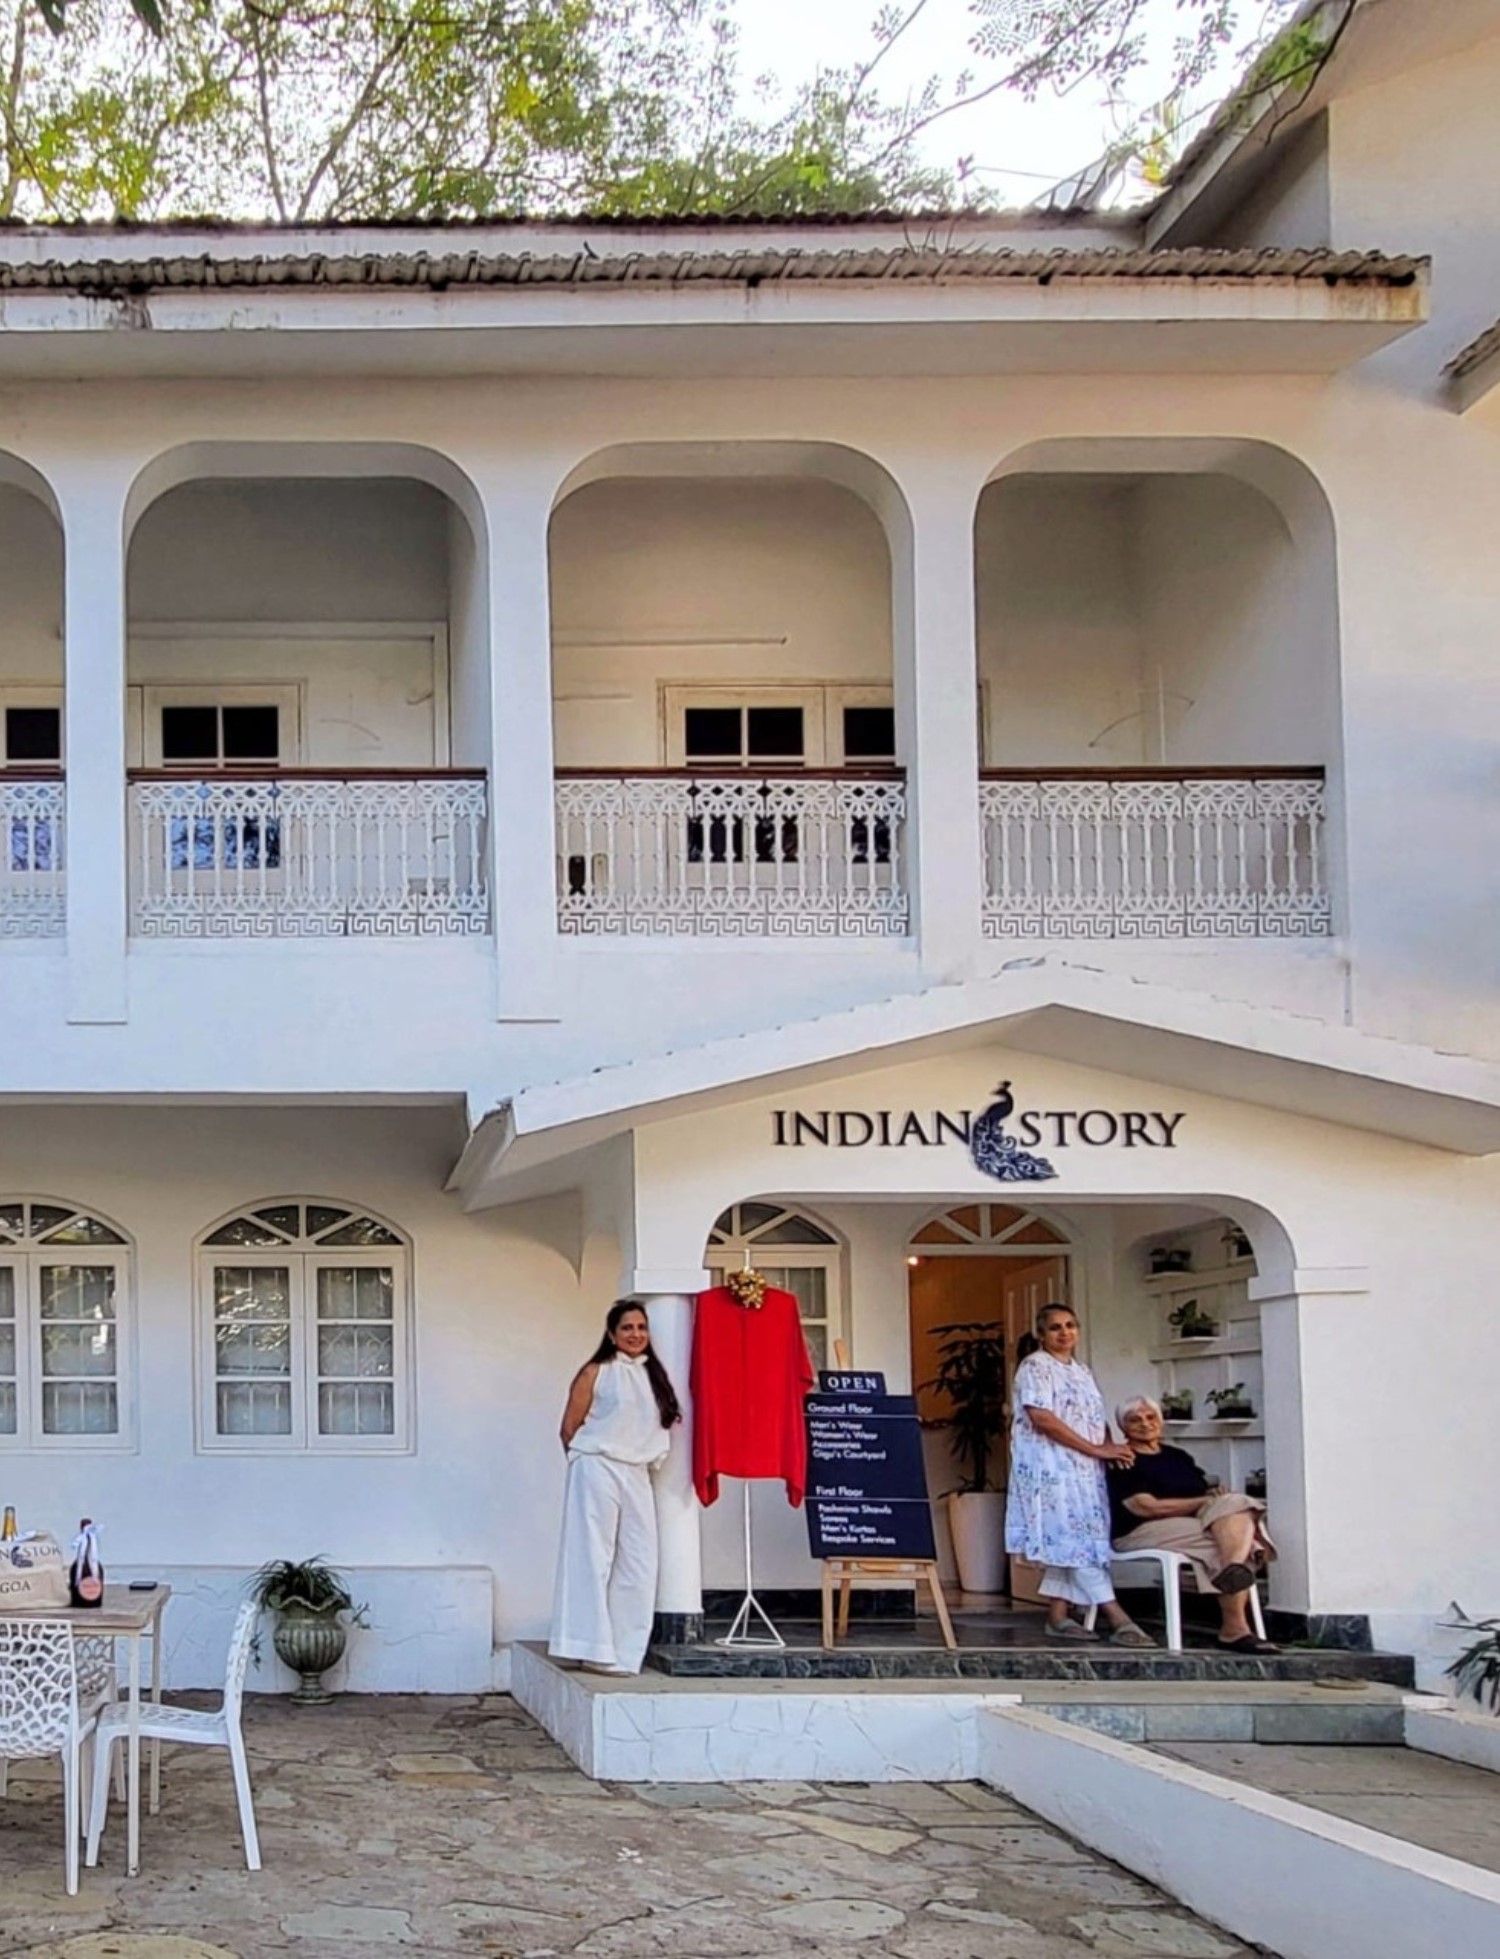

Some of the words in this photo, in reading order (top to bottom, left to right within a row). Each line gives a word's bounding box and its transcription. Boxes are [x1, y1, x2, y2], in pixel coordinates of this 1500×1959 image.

[773, 1110, 971, 1147] INDIAN
[1019, 1110, 1186, 1148] STORY
[827, 1376, 877, 1389] OPEN
[807, 1403, 846, 1413] Ground
[848, 1403, 873, 1413] Floor
[810, 1421, 837, 1429] Men's
[853, 1432, 878, 1440] Wear
[812, 1441, 861, 1449] Accessories
[843, 1450, 886, 1460] Courtyard
[816, 1486, 836, 1495] First
[838, 1486, 863, 1496] Floor
[818, 1504, 859, 1513] Pashmina
[861, 1505, 892, 1514] Shawls
[821, 1524, 847, 1532] Men's
[849, 1525, 877, 1533] Kurtas
[821, 1534, 858, 1543] Bespoke
[860, 1534, 896, 1544] Services
[0, 1580, 31, 1594] GOA
